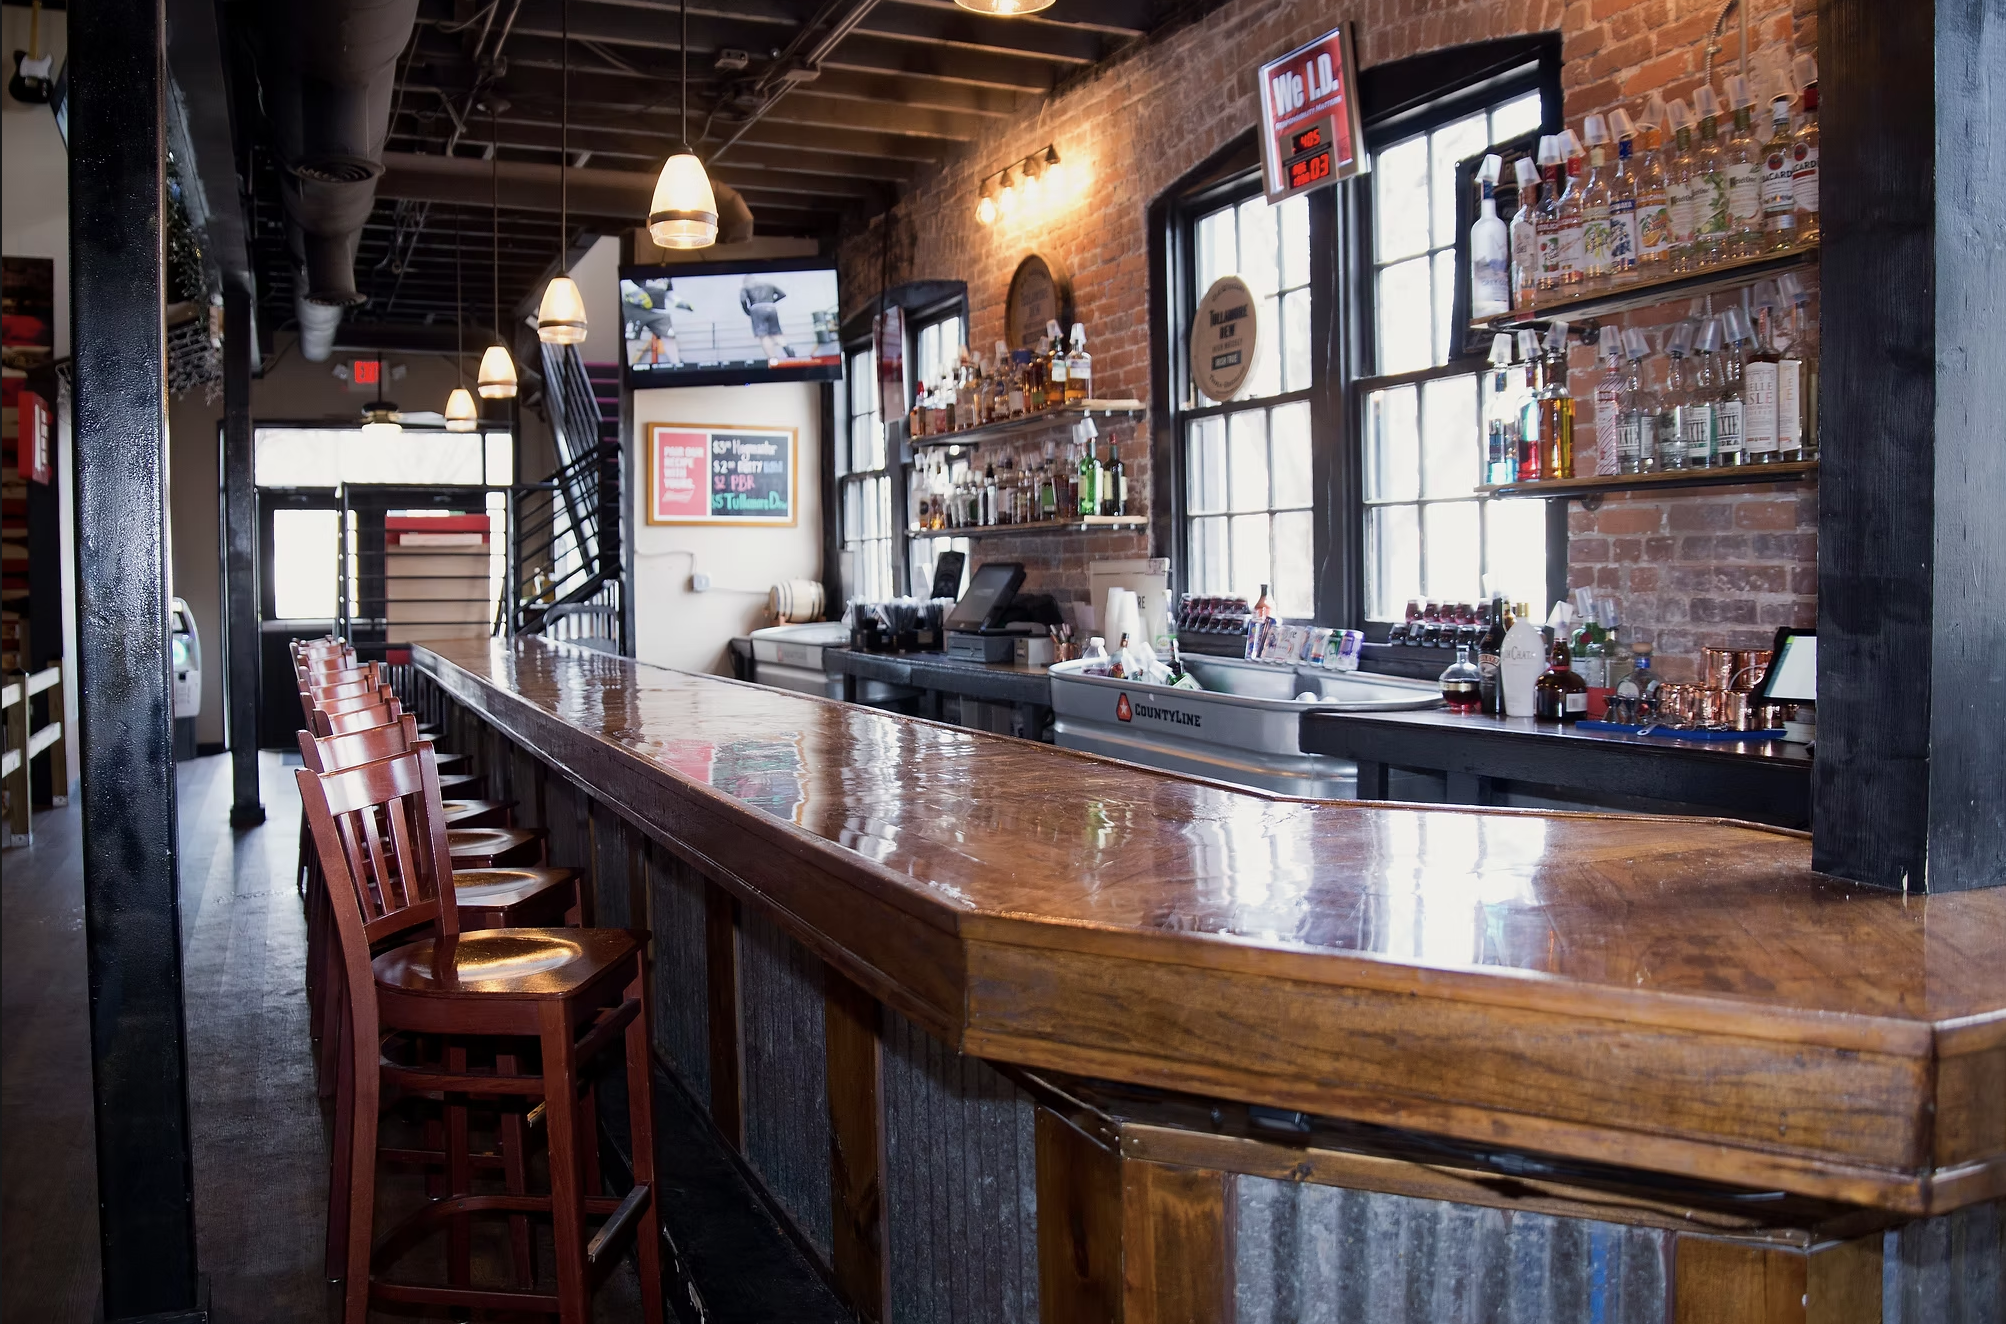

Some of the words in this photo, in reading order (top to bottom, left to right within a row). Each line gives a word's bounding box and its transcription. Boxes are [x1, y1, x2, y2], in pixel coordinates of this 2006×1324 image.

[1272, 69, 1304, 117] We
[1306, 52, 1339, 101] I.D.
[1309, 153, 1330, 181] 03
[1210, 304, 1248, 328] TULLAMORE
[1219, 323, 1235, 339] DEW
[730, 473, 756, 491] PBR
